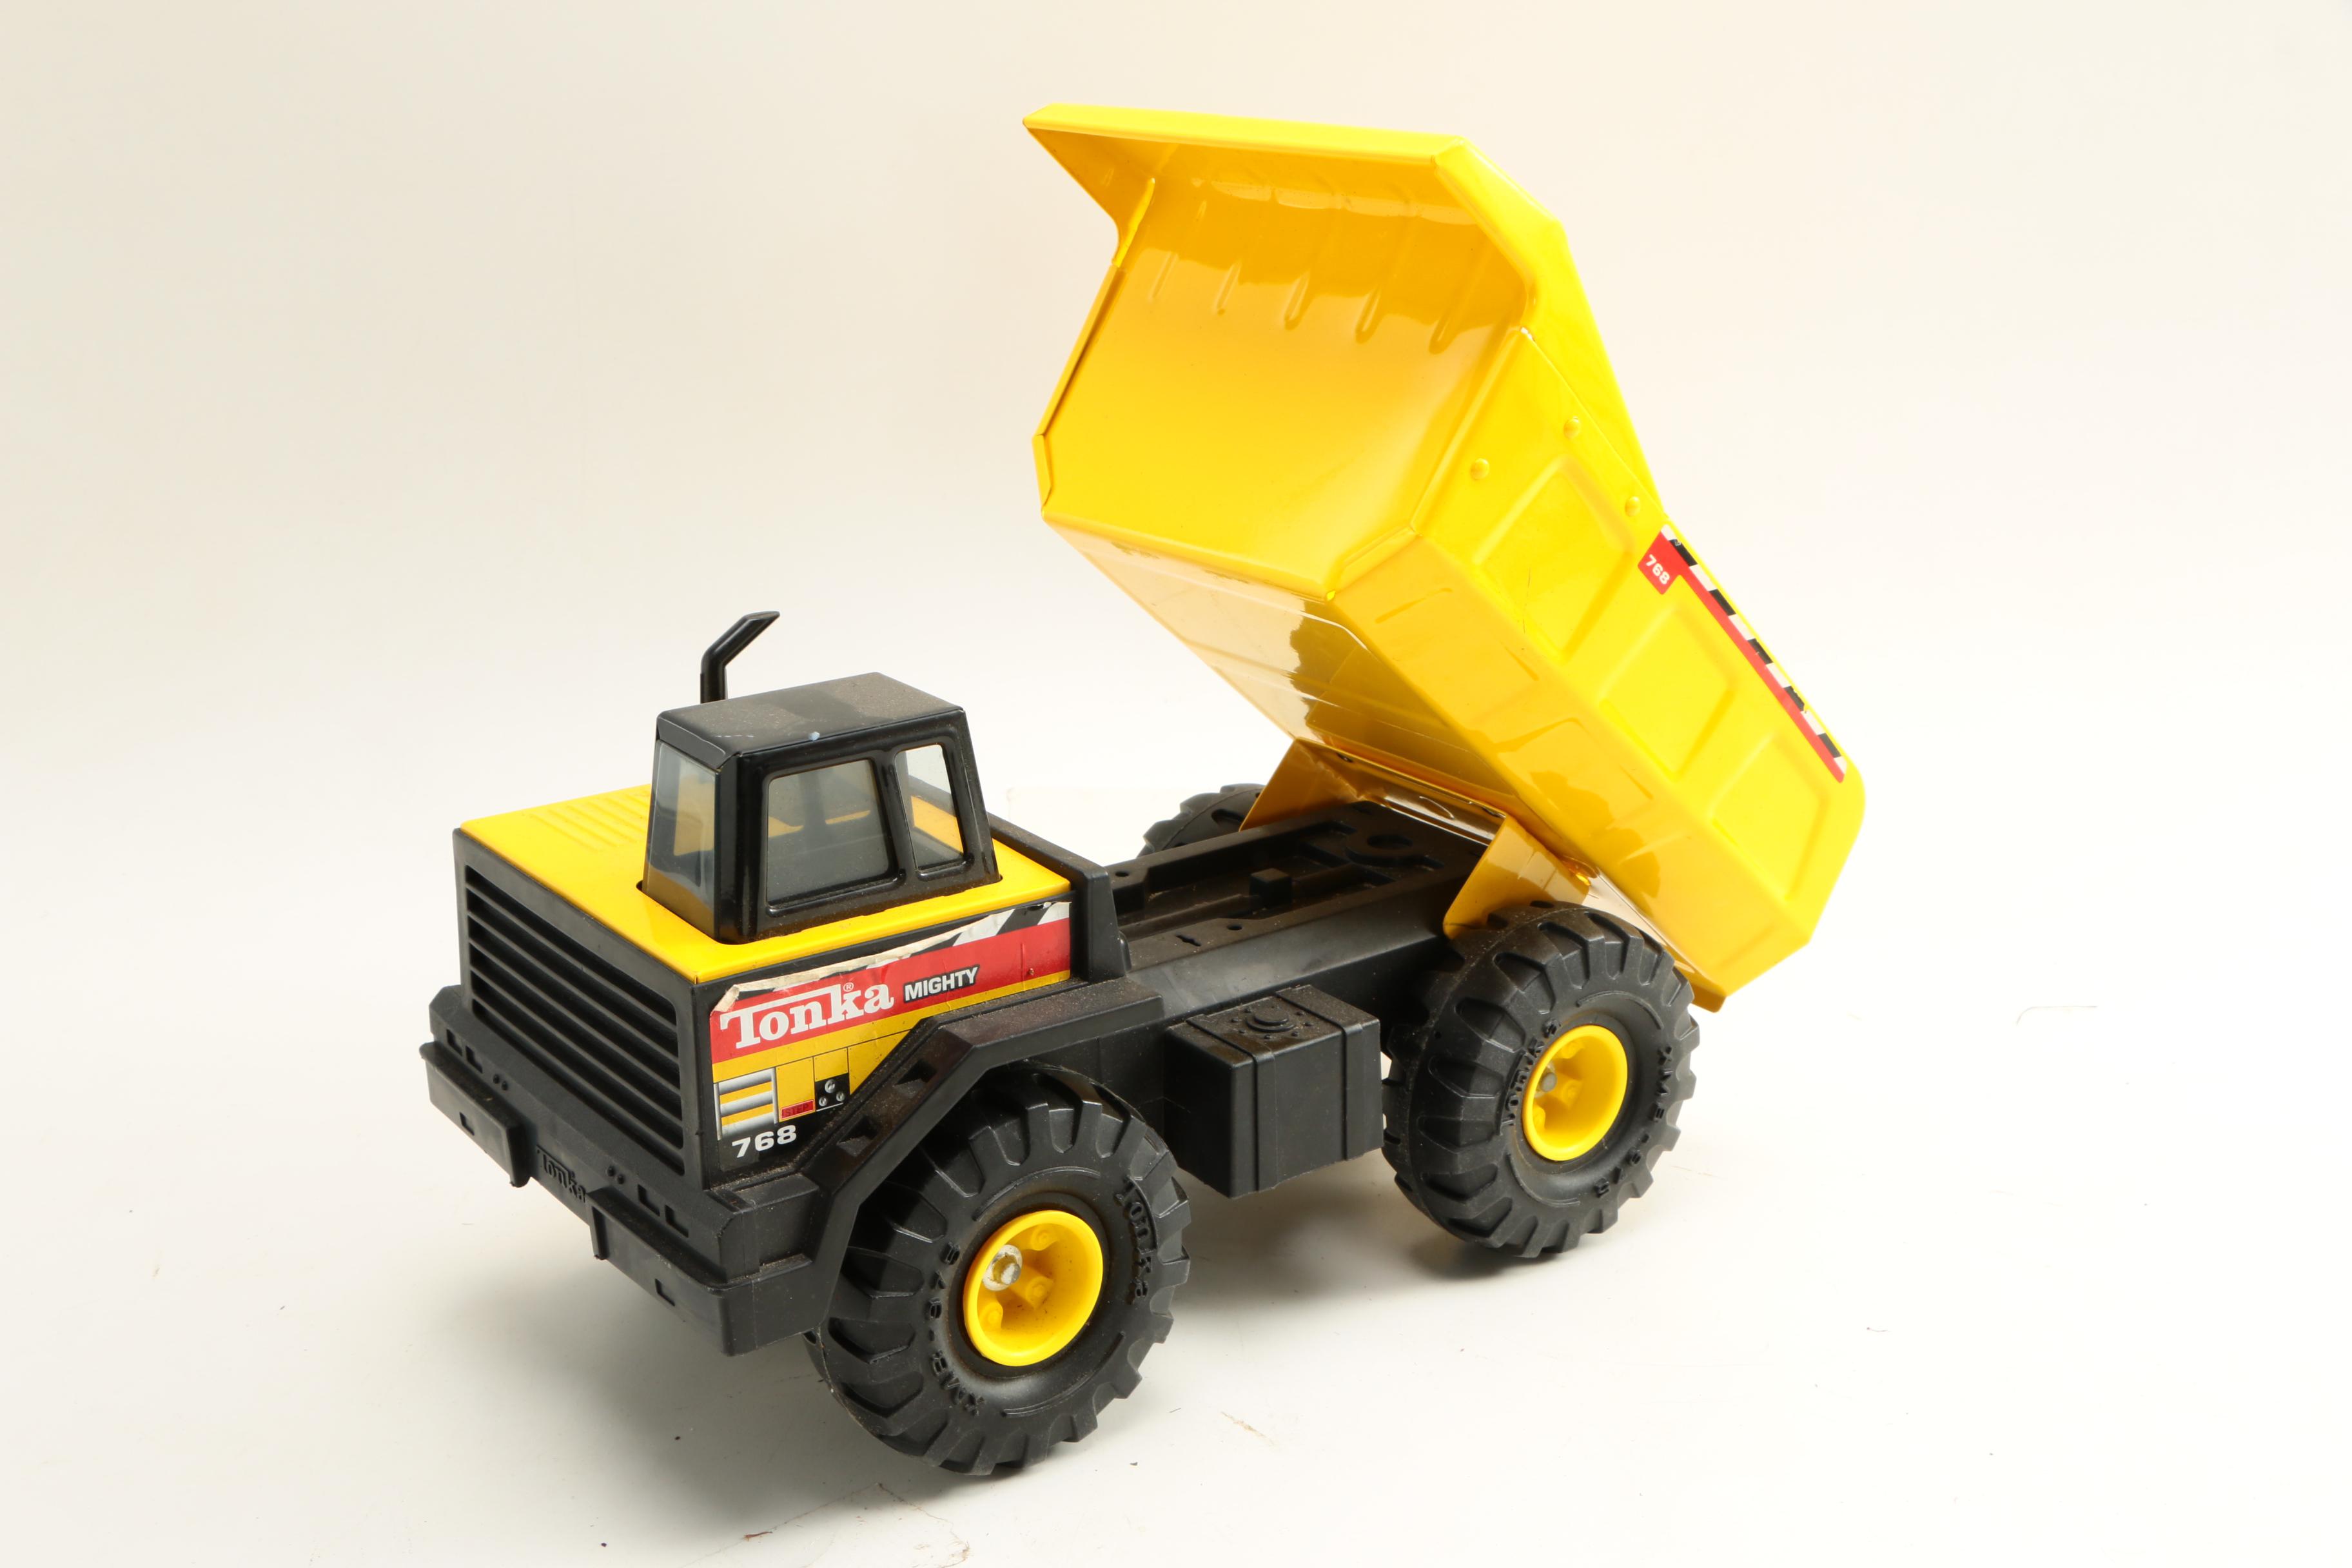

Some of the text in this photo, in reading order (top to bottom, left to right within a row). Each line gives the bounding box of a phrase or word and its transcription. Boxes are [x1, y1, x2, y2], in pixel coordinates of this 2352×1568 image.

[1646, 554, 1670, 585] 768
[905, 967, 977, 1001] MIGHTY
[732, 1124, 797, 1158] 768
